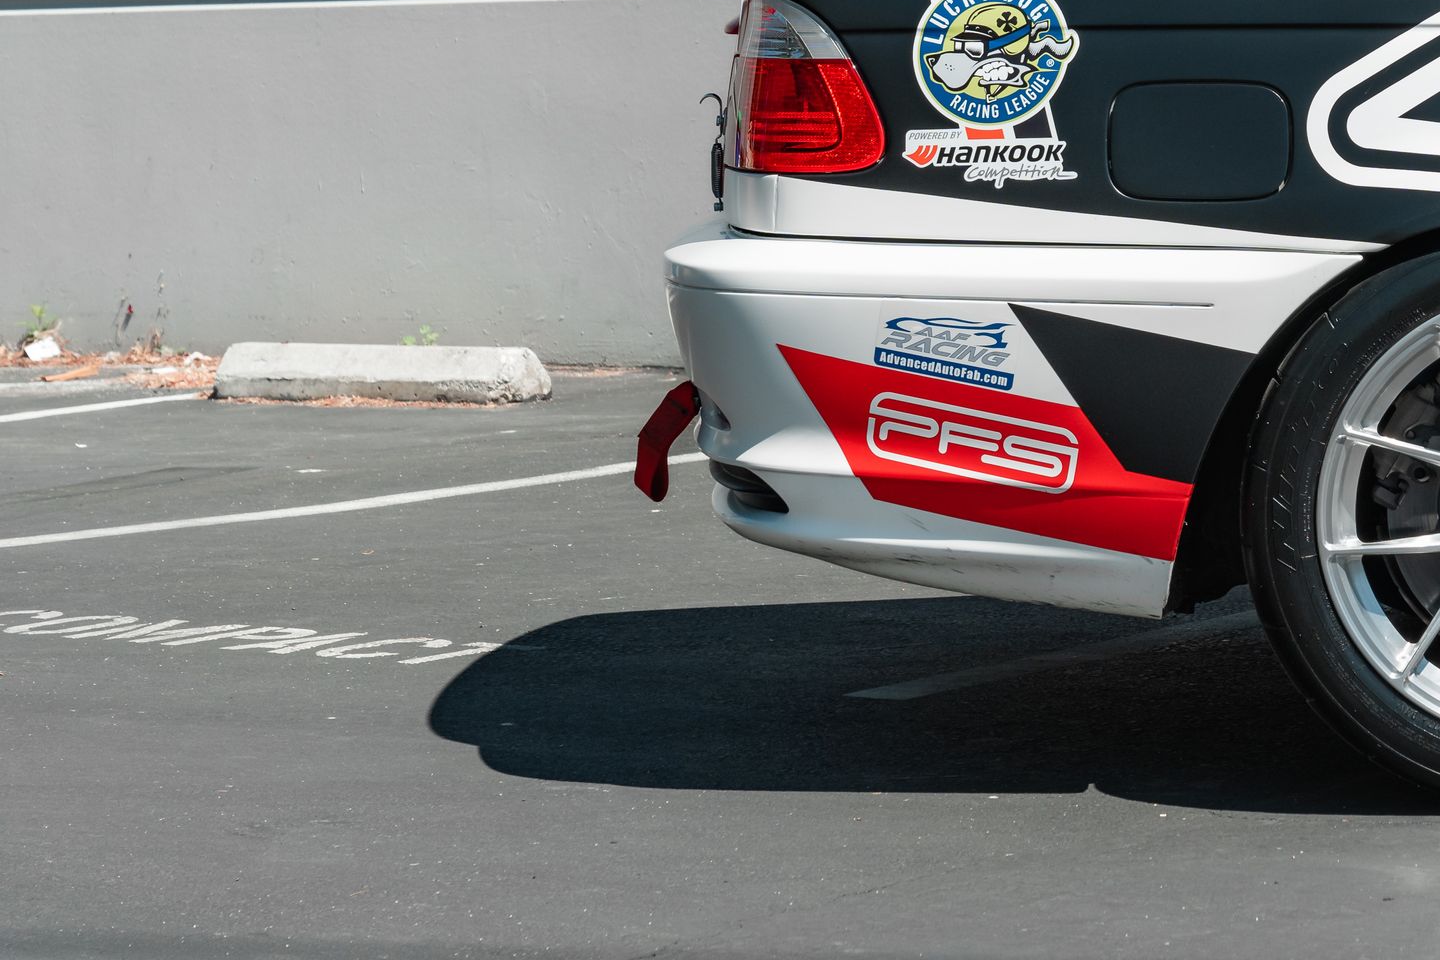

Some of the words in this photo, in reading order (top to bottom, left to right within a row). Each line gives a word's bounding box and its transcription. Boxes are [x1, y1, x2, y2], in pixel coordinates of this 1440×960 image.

[950, 95, 999, 119] RACING
[1004, 73, 1050, 115] LEAGUE
[908, 131, 948, 140] POWERED
[950, 131, 962, 139] BY
[967, 164, 1076, 187] Competition
[914, 326, 970, 342] AAF
[881, 331, 1011, 367] RACING
[879, 351, 1008, 387] AdvancedAutoFab.com
